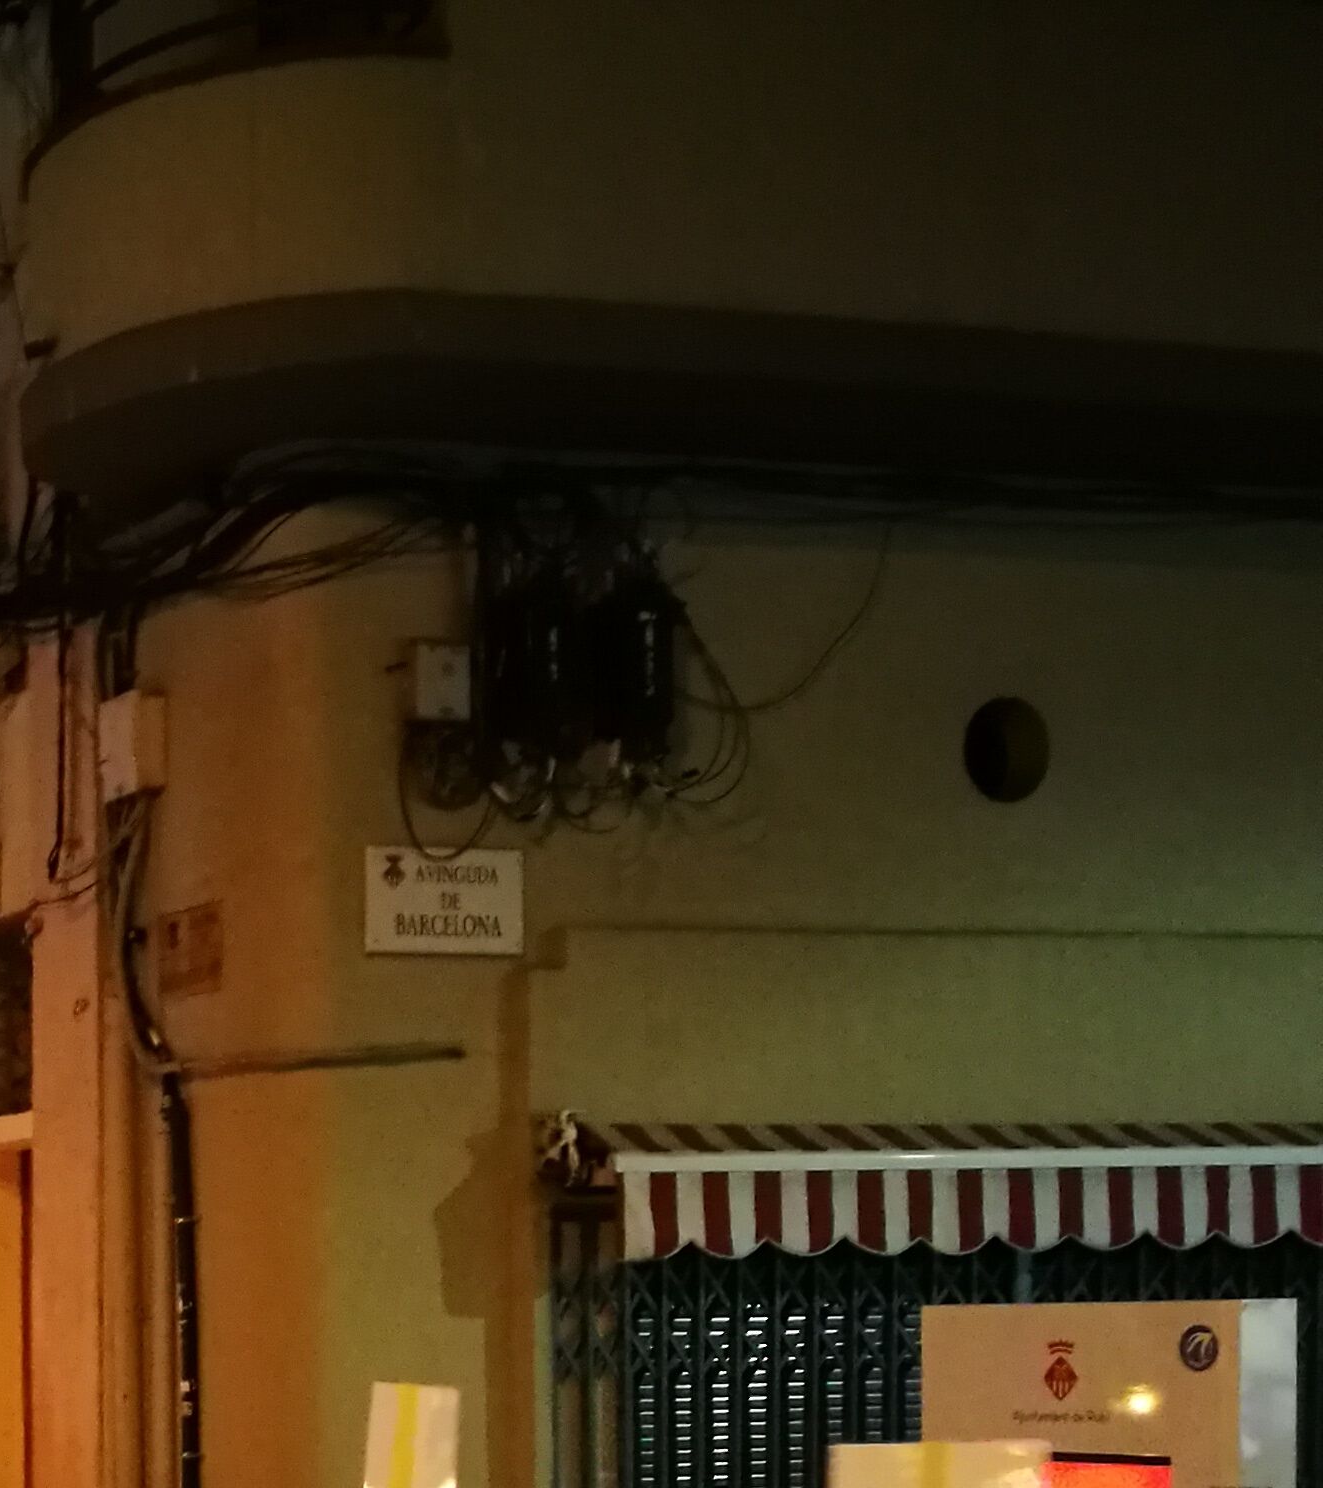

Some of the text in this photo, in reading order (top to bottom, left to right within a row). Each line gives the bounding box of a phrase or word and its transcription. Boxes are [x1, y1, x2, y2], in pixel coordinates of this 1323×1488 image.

[415, 865, 498, 887] AVINGUDA
[440, 892, 460, 910] DE
[393, 913, 502, 937] BARCELONA
